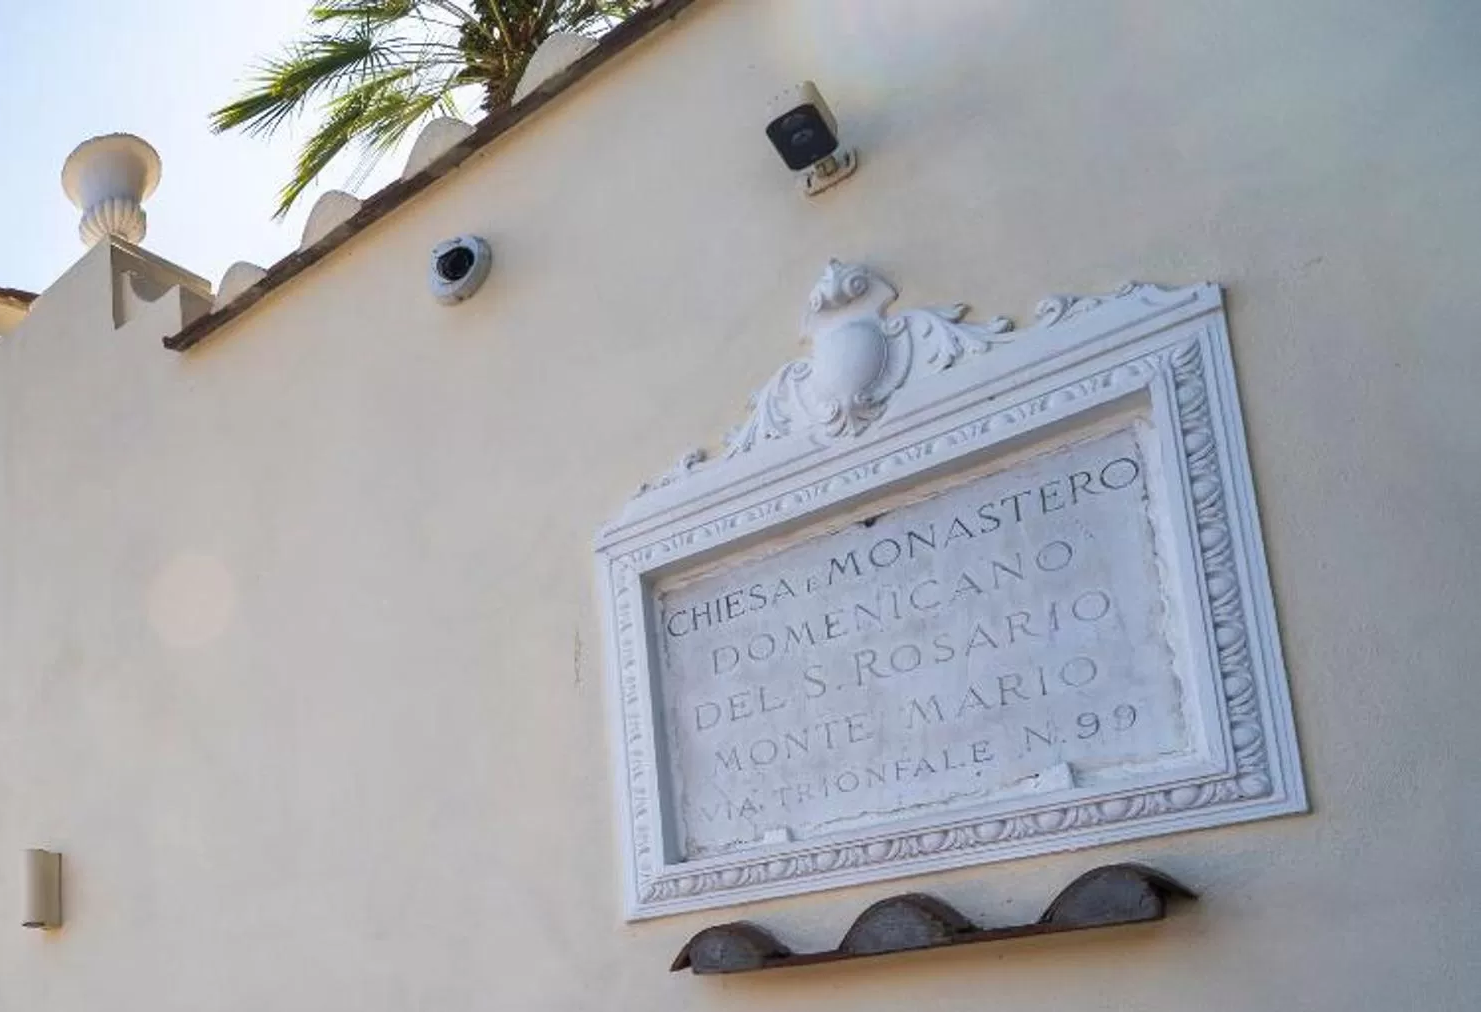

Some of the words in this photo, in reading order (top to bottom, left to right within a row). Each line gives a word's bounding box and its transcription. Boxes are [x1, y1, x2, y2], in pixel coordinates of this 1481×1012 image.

[667, 578, 796, 637] CHIESA
[828, 457, 1140, 585] MONASTERO
[712, 540, 1074, 677] DOMENICANO
[695, 686, 786, 731] DEL
[714, 712, 873, 776] MONTE
[906, 656, 1098, 729] MARIO
[774, 740, 994, 807] TRIONFALE
